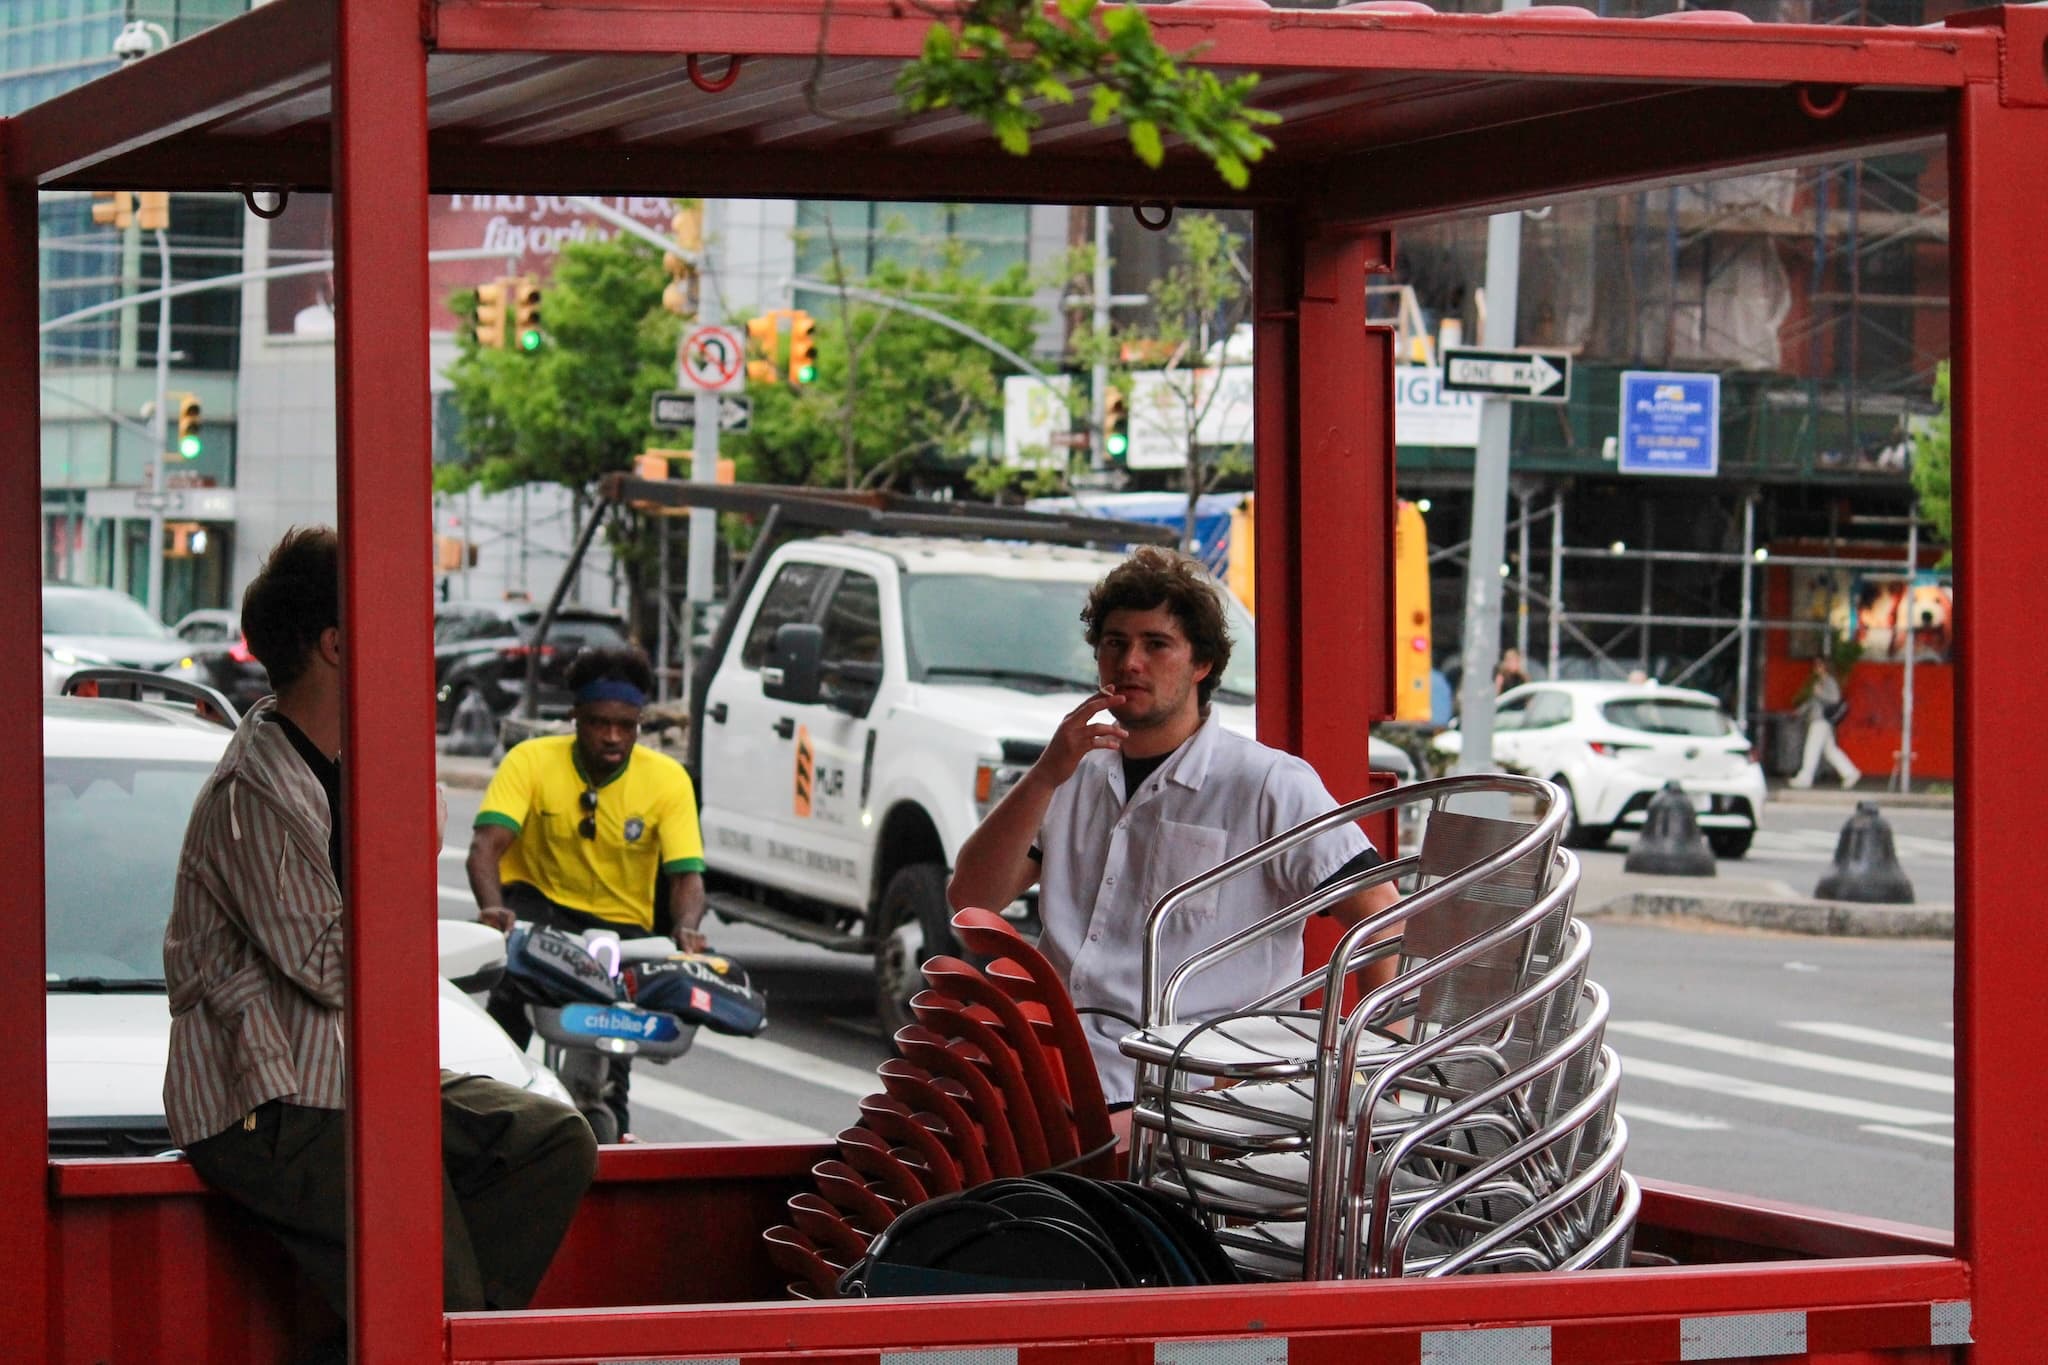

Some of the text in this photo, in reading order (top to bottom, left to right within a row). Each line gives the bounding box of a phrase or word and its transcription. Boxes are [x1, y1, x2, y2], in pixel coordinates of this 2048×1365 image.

[1461, 362, 1547, 383] ONE WAY
[584, 1013, 642, 1033] citi bike
